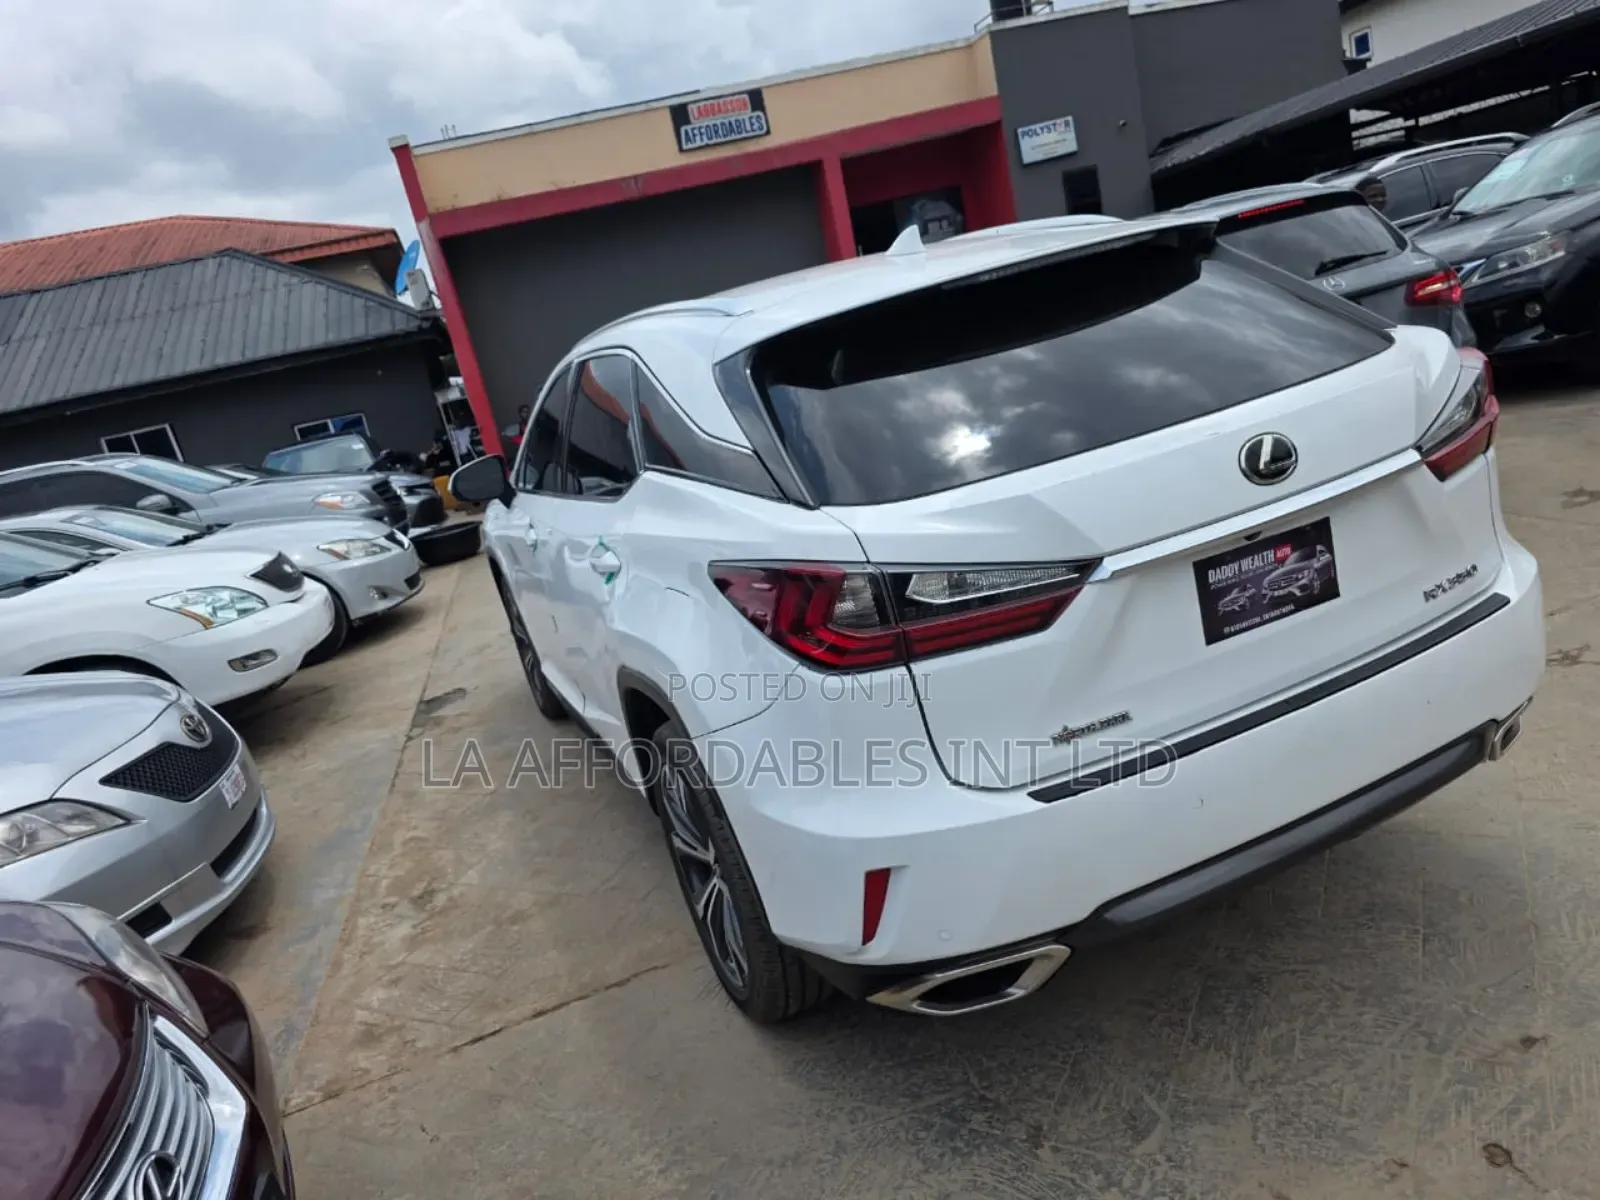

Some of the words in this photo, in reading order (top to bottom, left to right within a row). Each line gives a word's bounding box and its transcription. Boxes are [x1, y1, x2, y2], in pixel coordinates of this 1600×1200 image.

[683, 114, 765, 147] AFFORDABLES
[1208, 560, 1241, 583] DADDY
[1240, 549, 1275, 571] WEALTH
